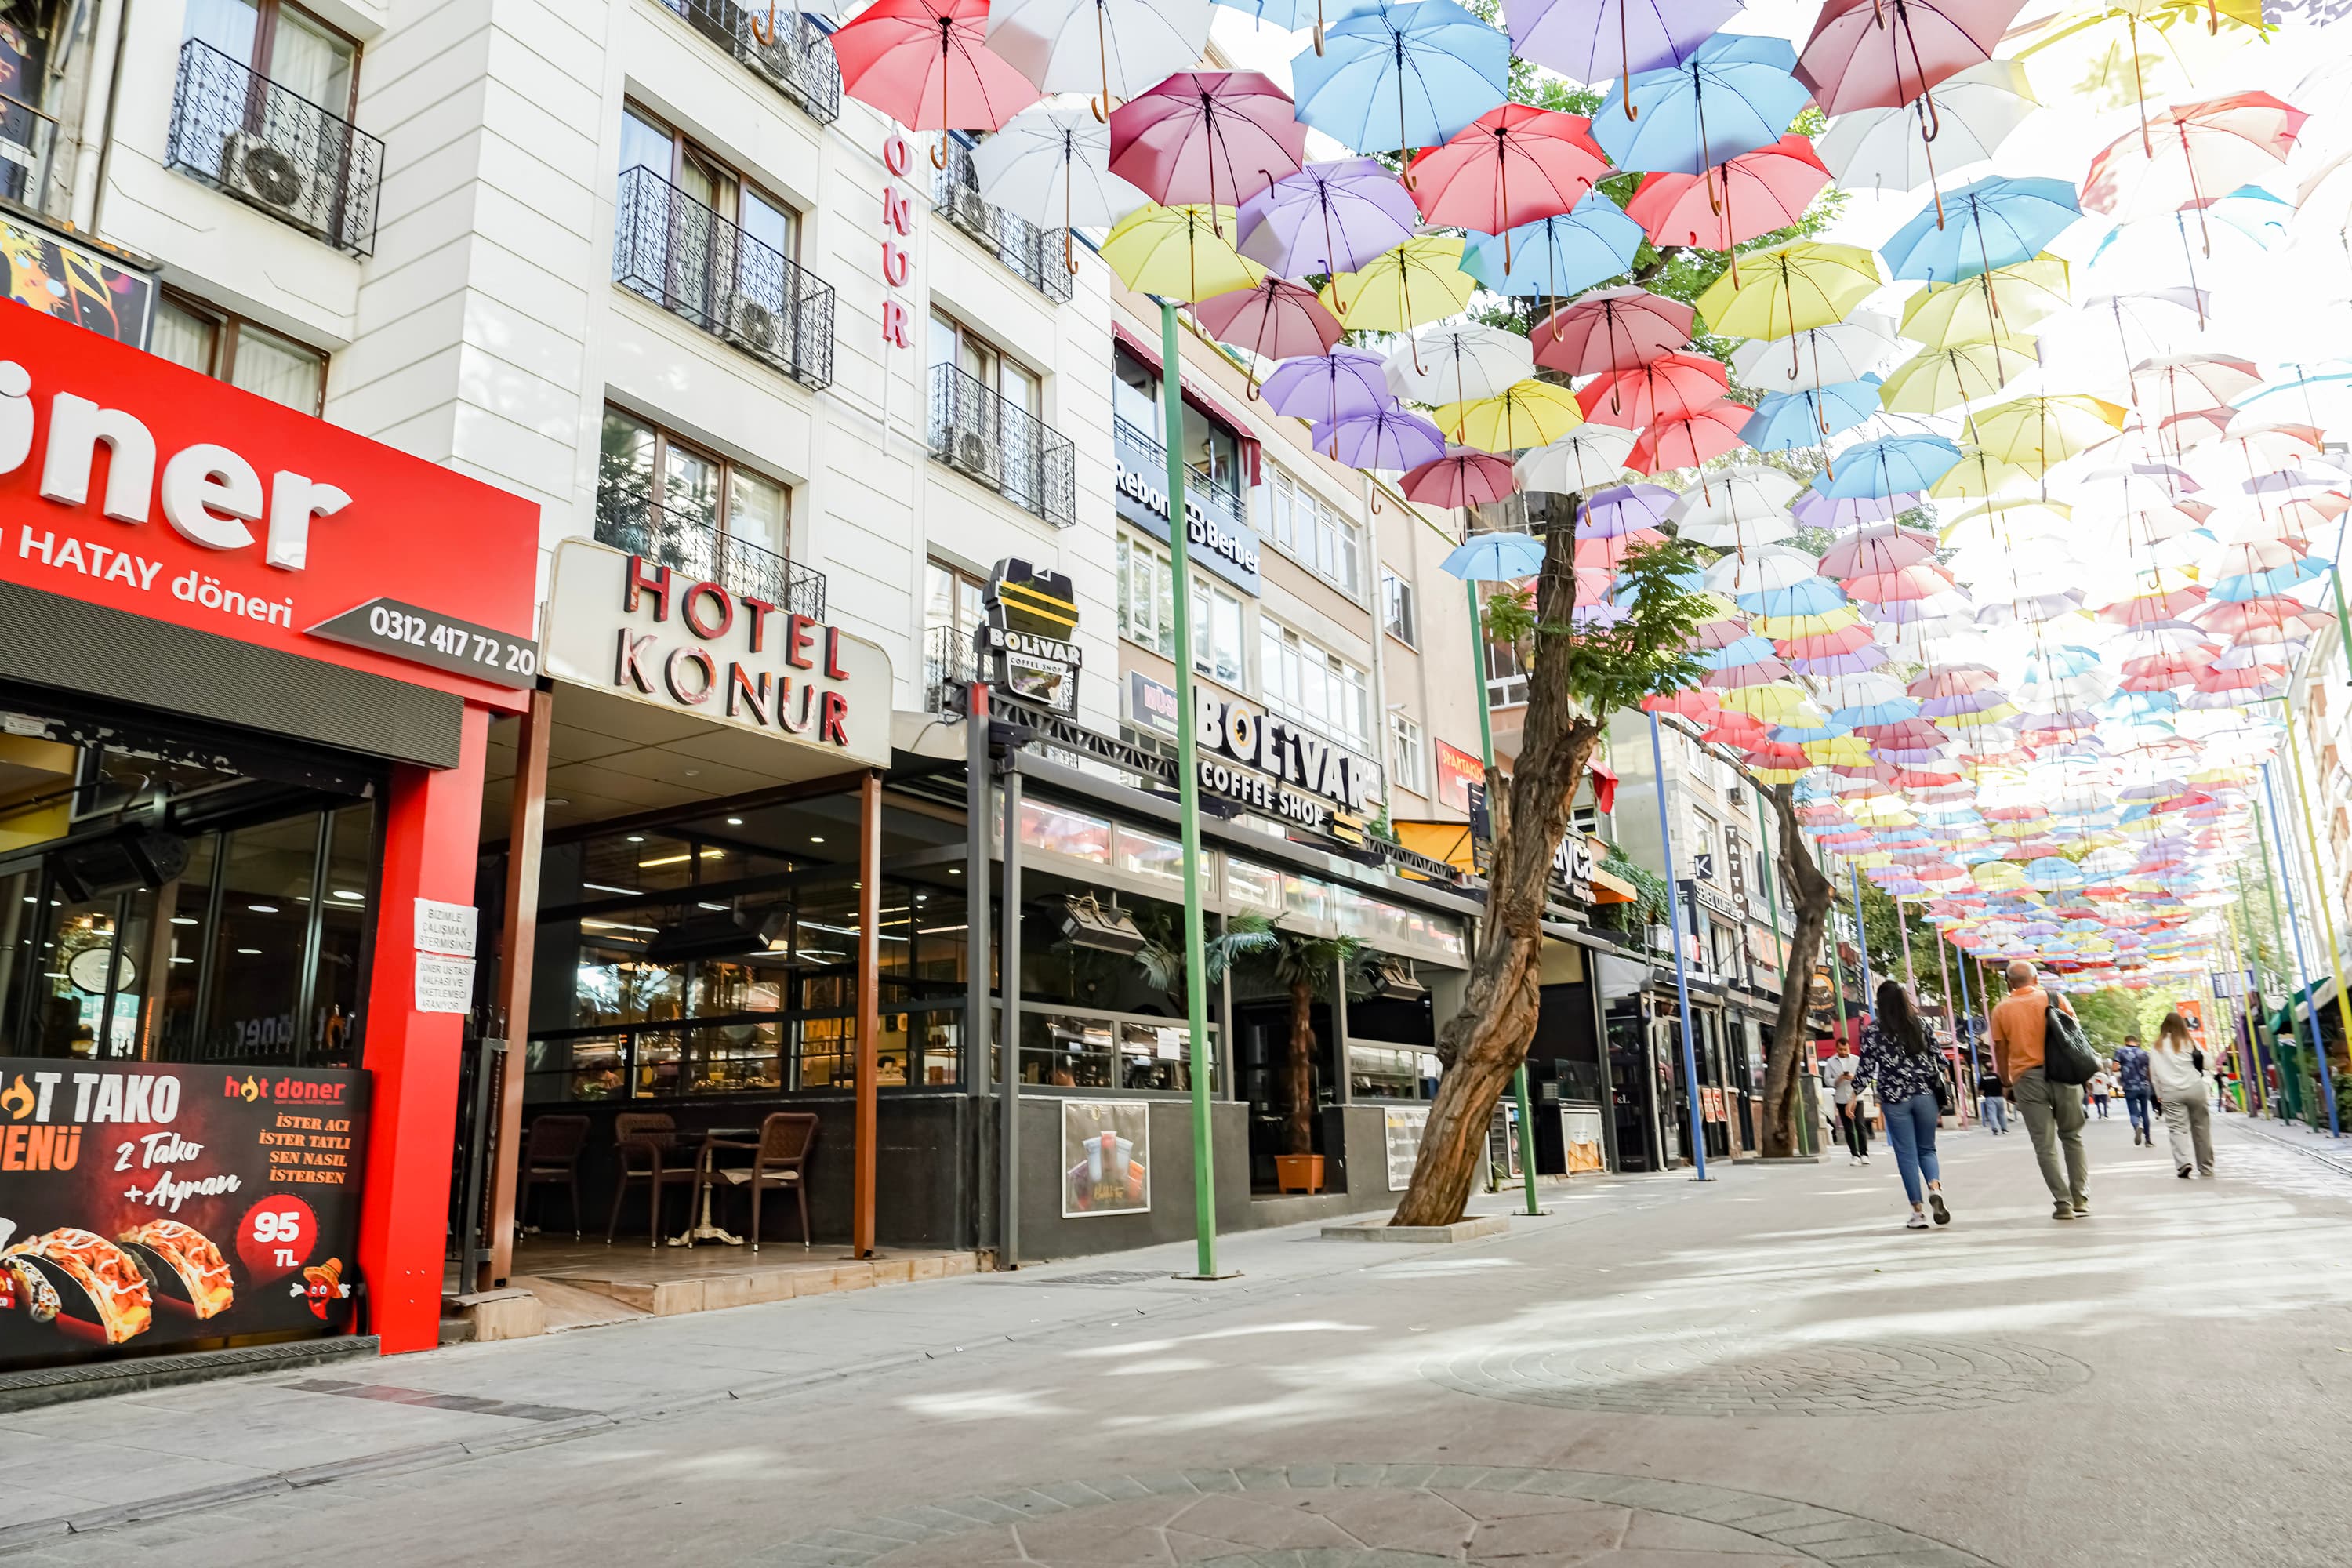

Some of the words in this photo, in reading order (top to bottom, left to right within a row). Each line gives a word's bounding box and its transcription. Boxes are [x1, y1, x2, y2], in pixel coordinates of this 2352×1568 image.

[1207, 518, 1261, 574] Berber
[19, 524, 163, 592] HATAY
[172, 571, 293, 628] döneri
[370, 606, 424, 648] 0312
[430, 625, 470, 660] 417
[473, 635, 499, 666] 72
[505, 642, 535, 676] 20
[624, 555, 849, 681] HOTEL
[615, 628, 849, 747] KONUR
[1011, 657, 1039, 669] COFFEE
[1042, 663, 1062, 673] SHOP
[1201, 760, 1273, 810] COFFEE
[1279, 791, 1323, 828] SHOP
[1726, 827, 1746, 920] TATTOO
[74, 1074, 181, 1124] TAKO
[224, 1075, 270, 1102] hot
[274, 1077, 347, 1100] döner
[0, 1125, 82, 1171] ENÜ
[309, 1135, 351, 1149] TATLI
[325, 1119, 350, 1132] ACI
[114, 1142, 135, 1171] 2
[140, 1131, 205, 1170] Tako
[269, 1150, 301, 1164] SEN
[303, 1152, 347, 1167] NASIL
[253, 1211, 300, 1243] 95
[274, 1249, 299, 1267] TL
